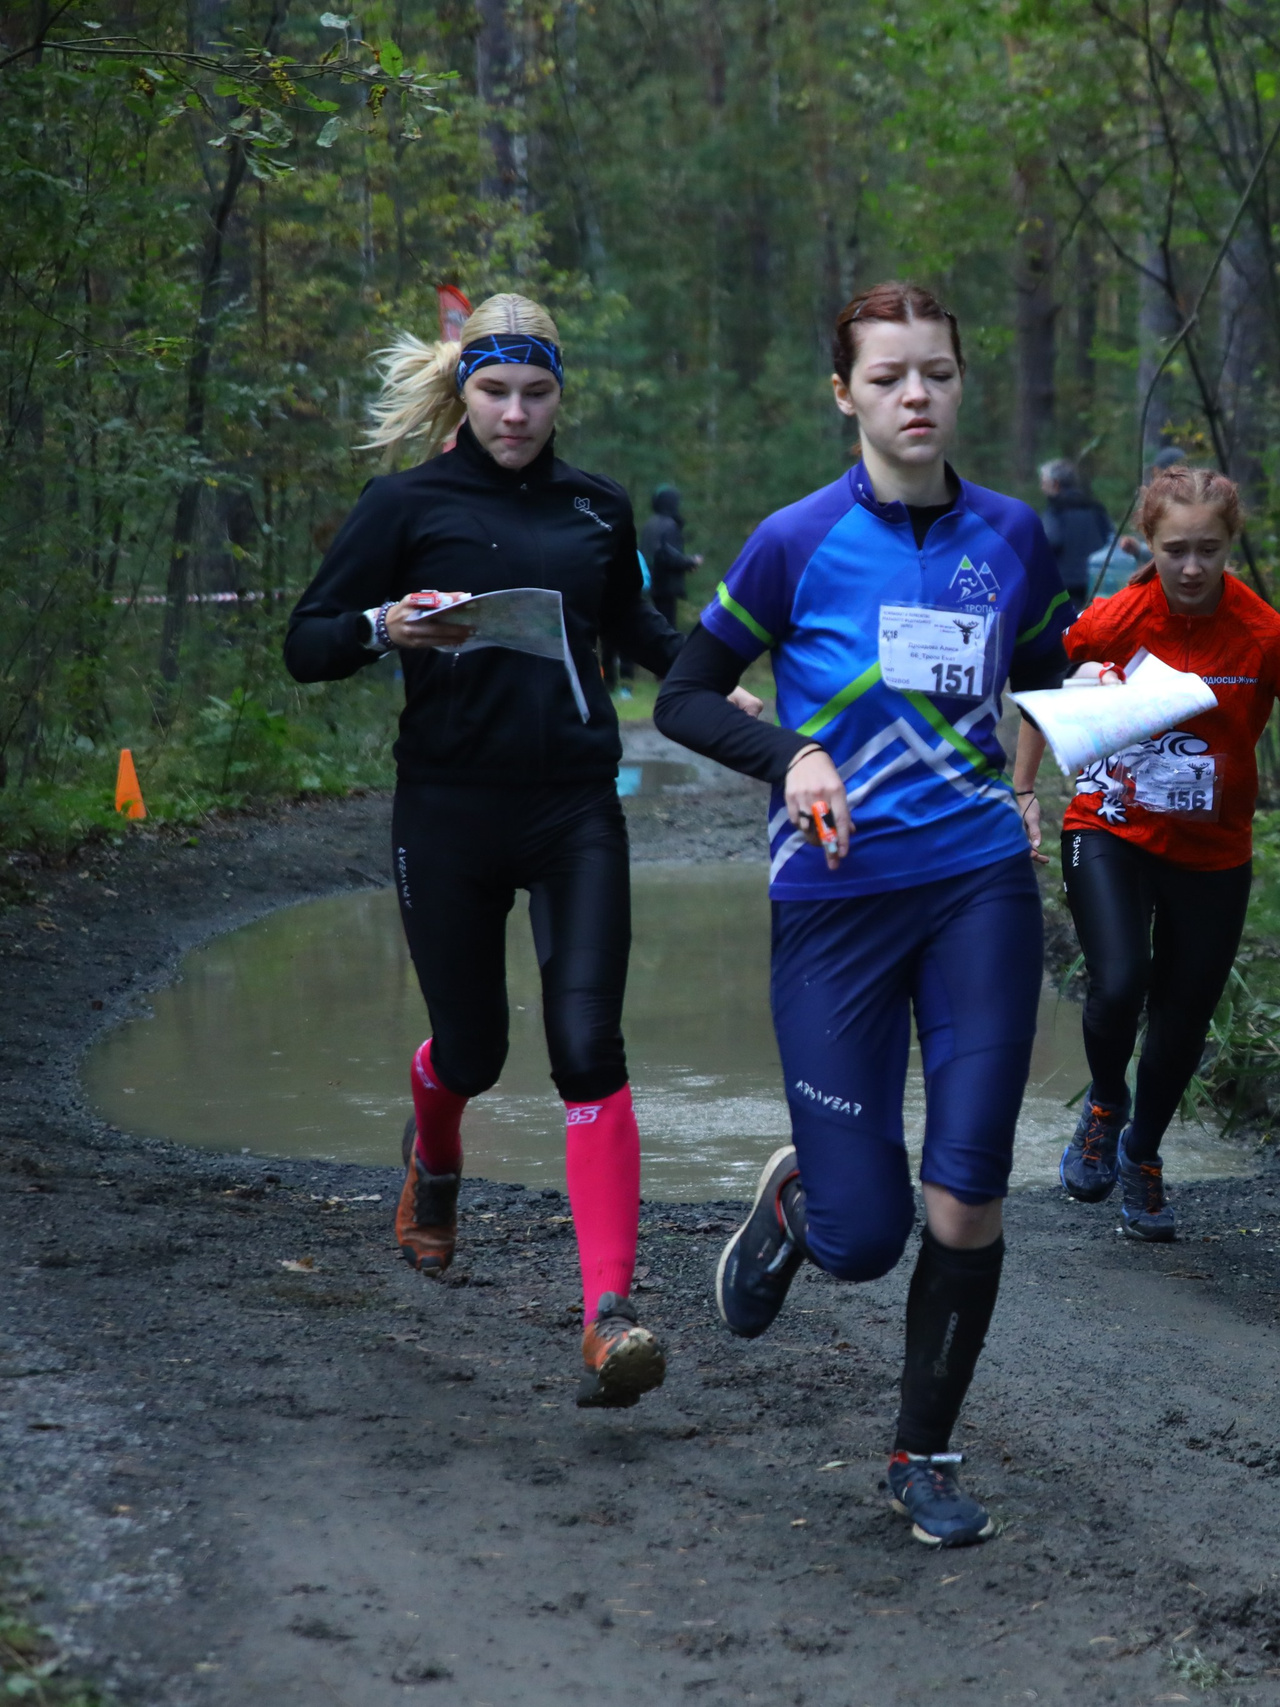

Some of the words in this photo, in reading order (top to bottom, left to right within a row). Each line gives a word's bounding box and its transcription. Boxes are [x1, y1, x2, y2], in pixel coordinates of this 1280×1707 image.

[965, 604, 993, 613] ТРОПА
[931, 663, 975, 696] 151
[1167, 789, 1207, 812] 156
